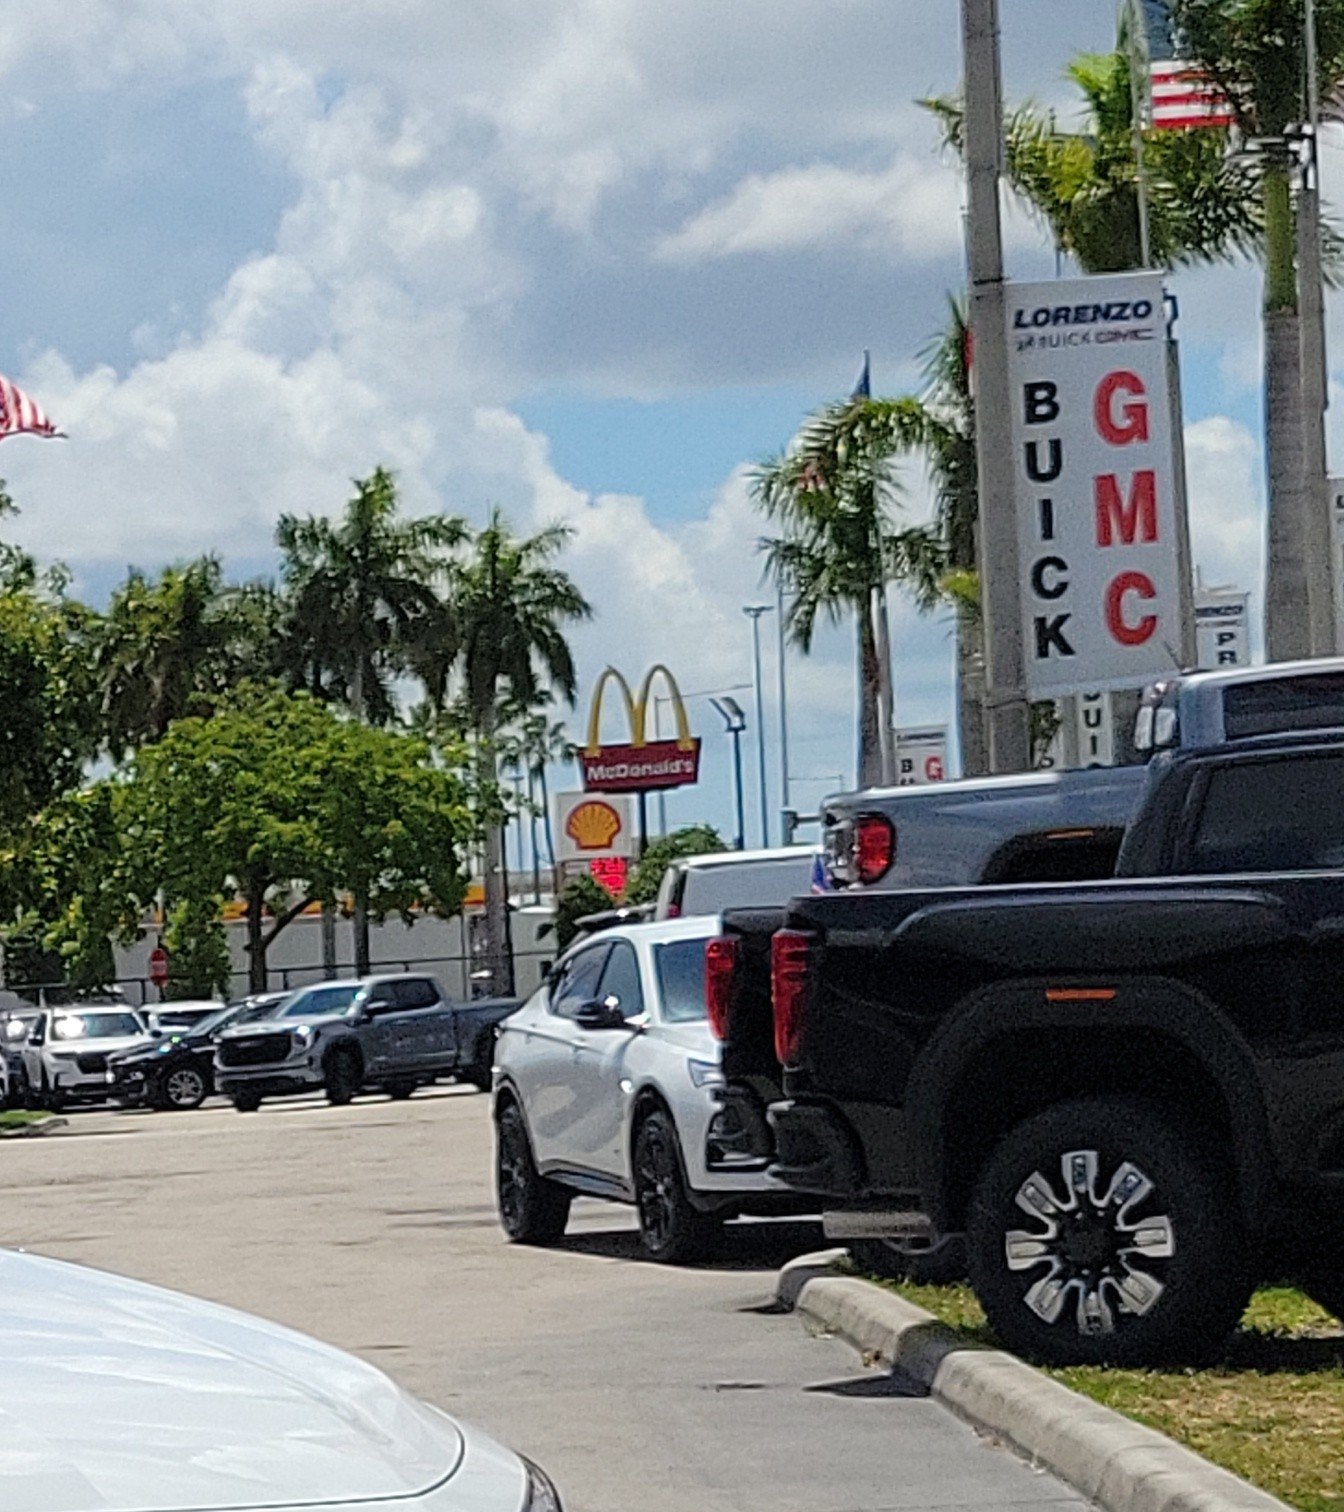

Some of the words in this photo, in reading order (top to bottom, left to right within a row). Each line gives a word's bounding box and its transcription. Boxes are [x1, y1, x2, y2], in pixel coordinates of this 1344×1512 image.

[1013, 300, 1153, 329] LORENZO
[1022, 380, 1076, 661] BUICK
[1092, 369, 1161, 647] GMC
[587, 759, 695, 781] McDonald's
